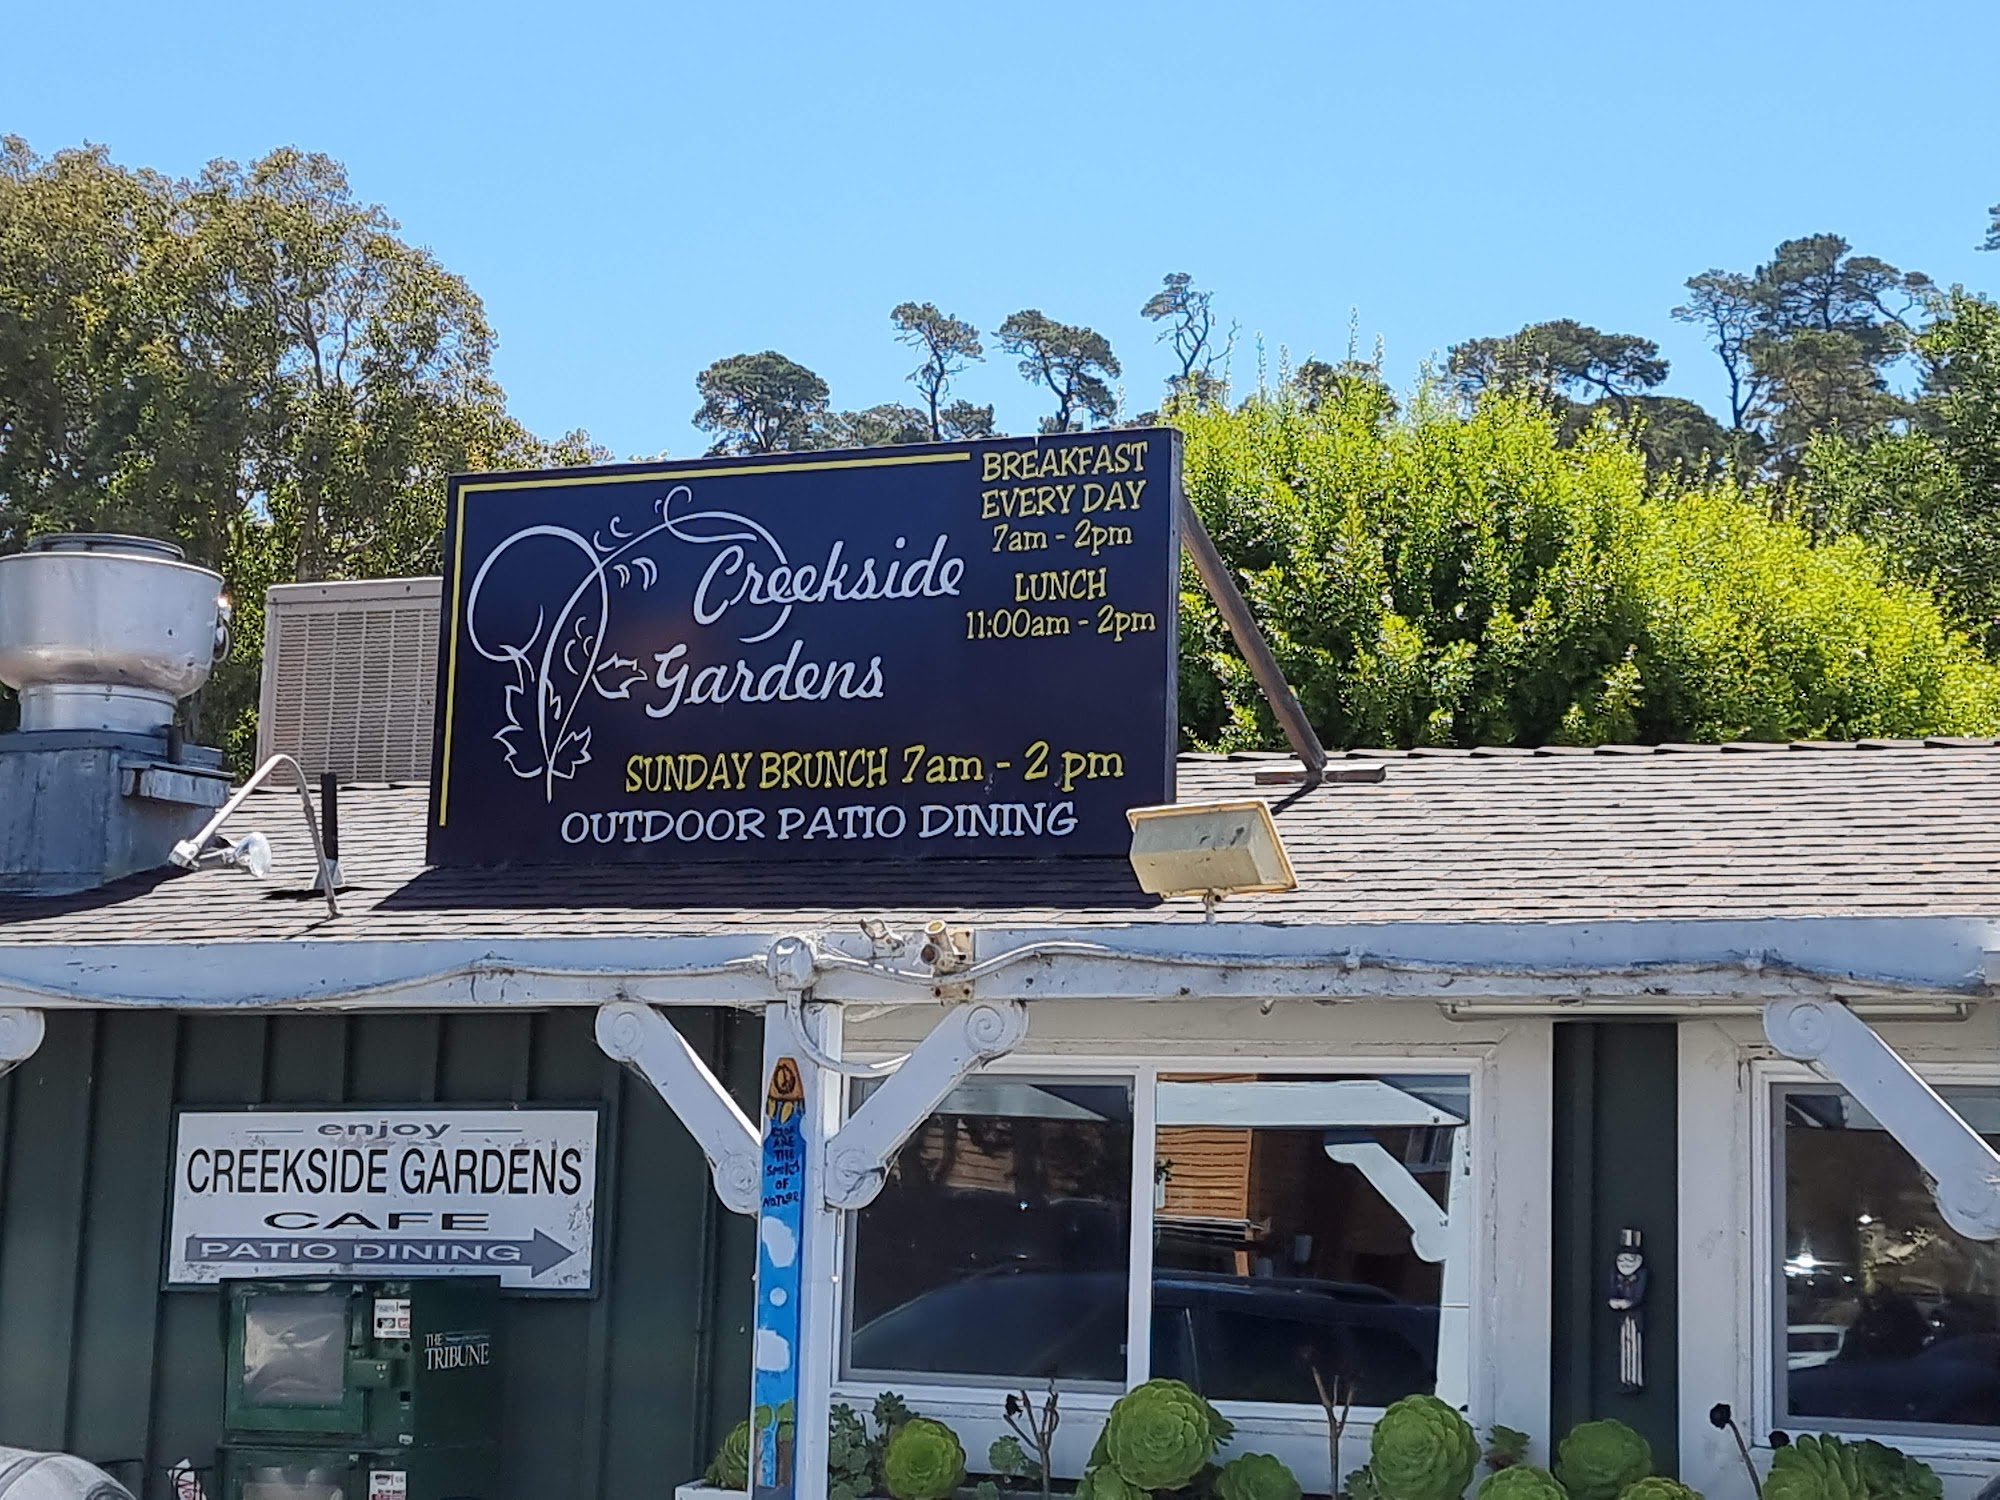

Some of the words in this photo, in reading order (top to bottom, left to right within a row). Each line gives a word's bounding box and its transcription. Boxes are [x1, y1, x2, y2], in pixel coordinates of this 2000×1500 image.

[982, 441, 1148, 482] BREAKFAST
[981, 484, 1076, 519] EVERY
[1082, 479, 1147, 513] DAY
[992, 523, 1048, 552] 7am
[1074, 519, 1133, 556] 2pm
[693, 534, 965, 625] Creekside
[1015, 567, 1107, 602] LUNCH
[966, 608, 1070, 639] 11:00am
[1097, 604, 1156, 642] 2pm
[646, 639, 884, 718] Gardens
[625, 752, 753, 792] SUNDAY
[759, 747, 888, 790] BRUNCH
[901, 744, 984, 784] 7am
[1023, 740, 1050, 781] 2
[1061, 750, 1124, 792] pm
[561, 808, 766, 844] OUTDOOR
[777, 805, 907, 840] PATIO
[918, 801, 1078, 839] DINING
[317, 1120, 451, 1140] enjoy
[186, 1148, 388, 1194] CREEKSIDE
[400, 1148, 582, 1195] GARDENS
[264, 1211, 490, 1231] CAFE
[200, 1242, 338, 1260] PATIO
[353, 1243, 521, 1262] DINING
[424, 1332, 444, 1348] THE
[424, 1342, 490, 1370] TRIBUNE
